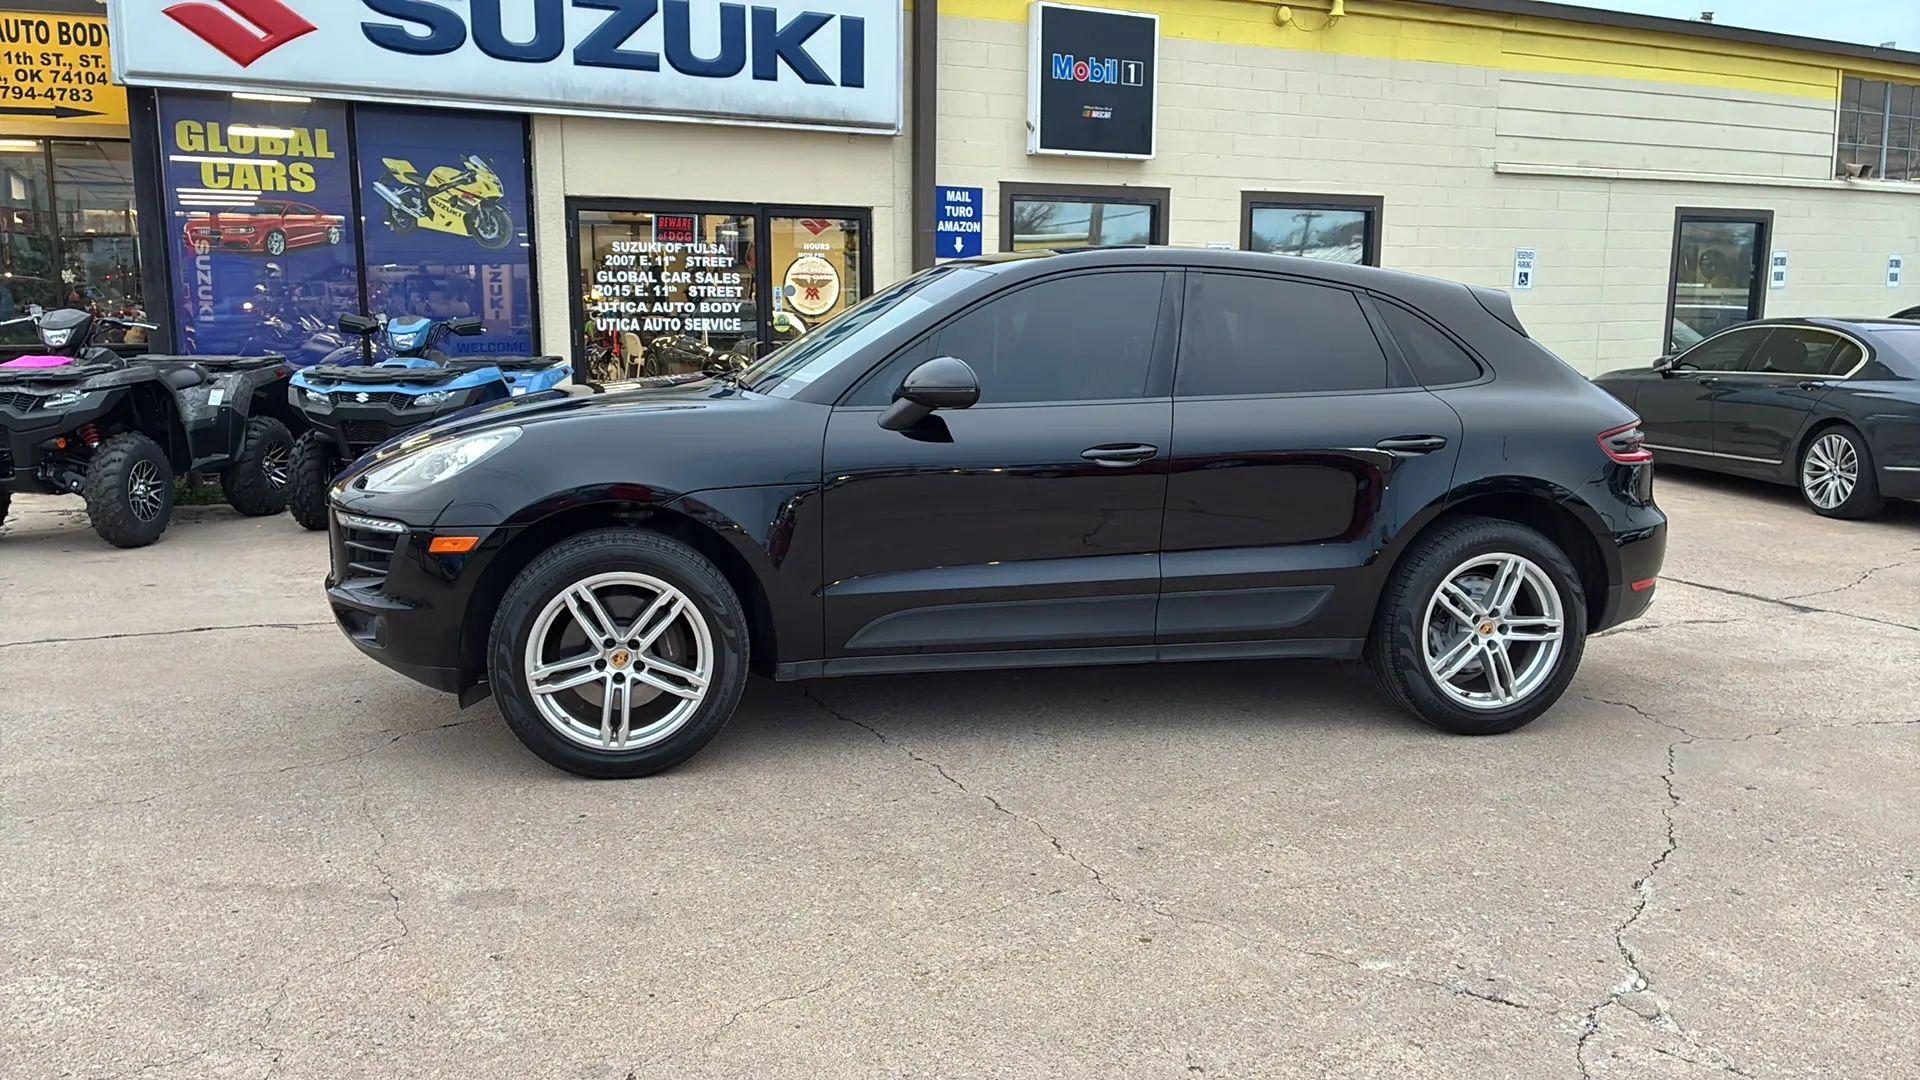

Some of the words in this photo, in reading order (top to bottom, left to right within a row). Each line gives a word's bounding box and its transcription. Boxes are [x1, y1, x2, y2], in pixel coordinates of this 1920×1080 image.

[361, 0, 866, 88] SUZUKI
[40, 52, 73, 70] ST.,
[79, 54, 106, 69] ST.
[1052, 53, 1118, 84] Mobil
[14, 68, 44, 83] OK
[49, 70, 108, 86] 74104
[0, 85, 94, 103] 794-4783
[175, 119, 335, 159] GLOBAL
[201, 161, 316, 193] CARS
[946, 190, 972, 203] MAIL
[944, 205, 974, 218] TURO
[658, 216, 692, 229] BEWARE
[937, 220, 981, 233] AMAZON
[658, 231, 667, 241] of
[668, 231, 692, 242] DOG
[612, 241, 661, 253] SUZUKI
[665, 243, 683, 253] OF
[687, 243, 727, 254] TULSA
[803, 242, 831, 251] HOURS
[605, 255, 636, 266] 2007
[640, 256, 652, 266] E.
[655, 256, 676, 267] 11th
[685, 256, 734, 267] STREET
[195, 239, 214, 321] SUZUKI
[596, 271, 657, 283] GLOBAL
[661, 271, 692, 283] CAR
[695, 272, 741, 284] SALES
[595, 284, 631, 297] 2015
[634, 285, 649, 297] E.
[653, 285, 677, 297] 11th
[688, 286, 743, 297] STREET
[597, 302, 649, 313] UTICA
[652, 302, 696, 313] AUTO
[700, 302, 742, 313] BODY
[596, 318, 641, 331] UTICA
[644, 318, 681, 331] AUTO
[684, 318, 741, 331] SERVICE
[456, 341, 528, 354] WELCOME
